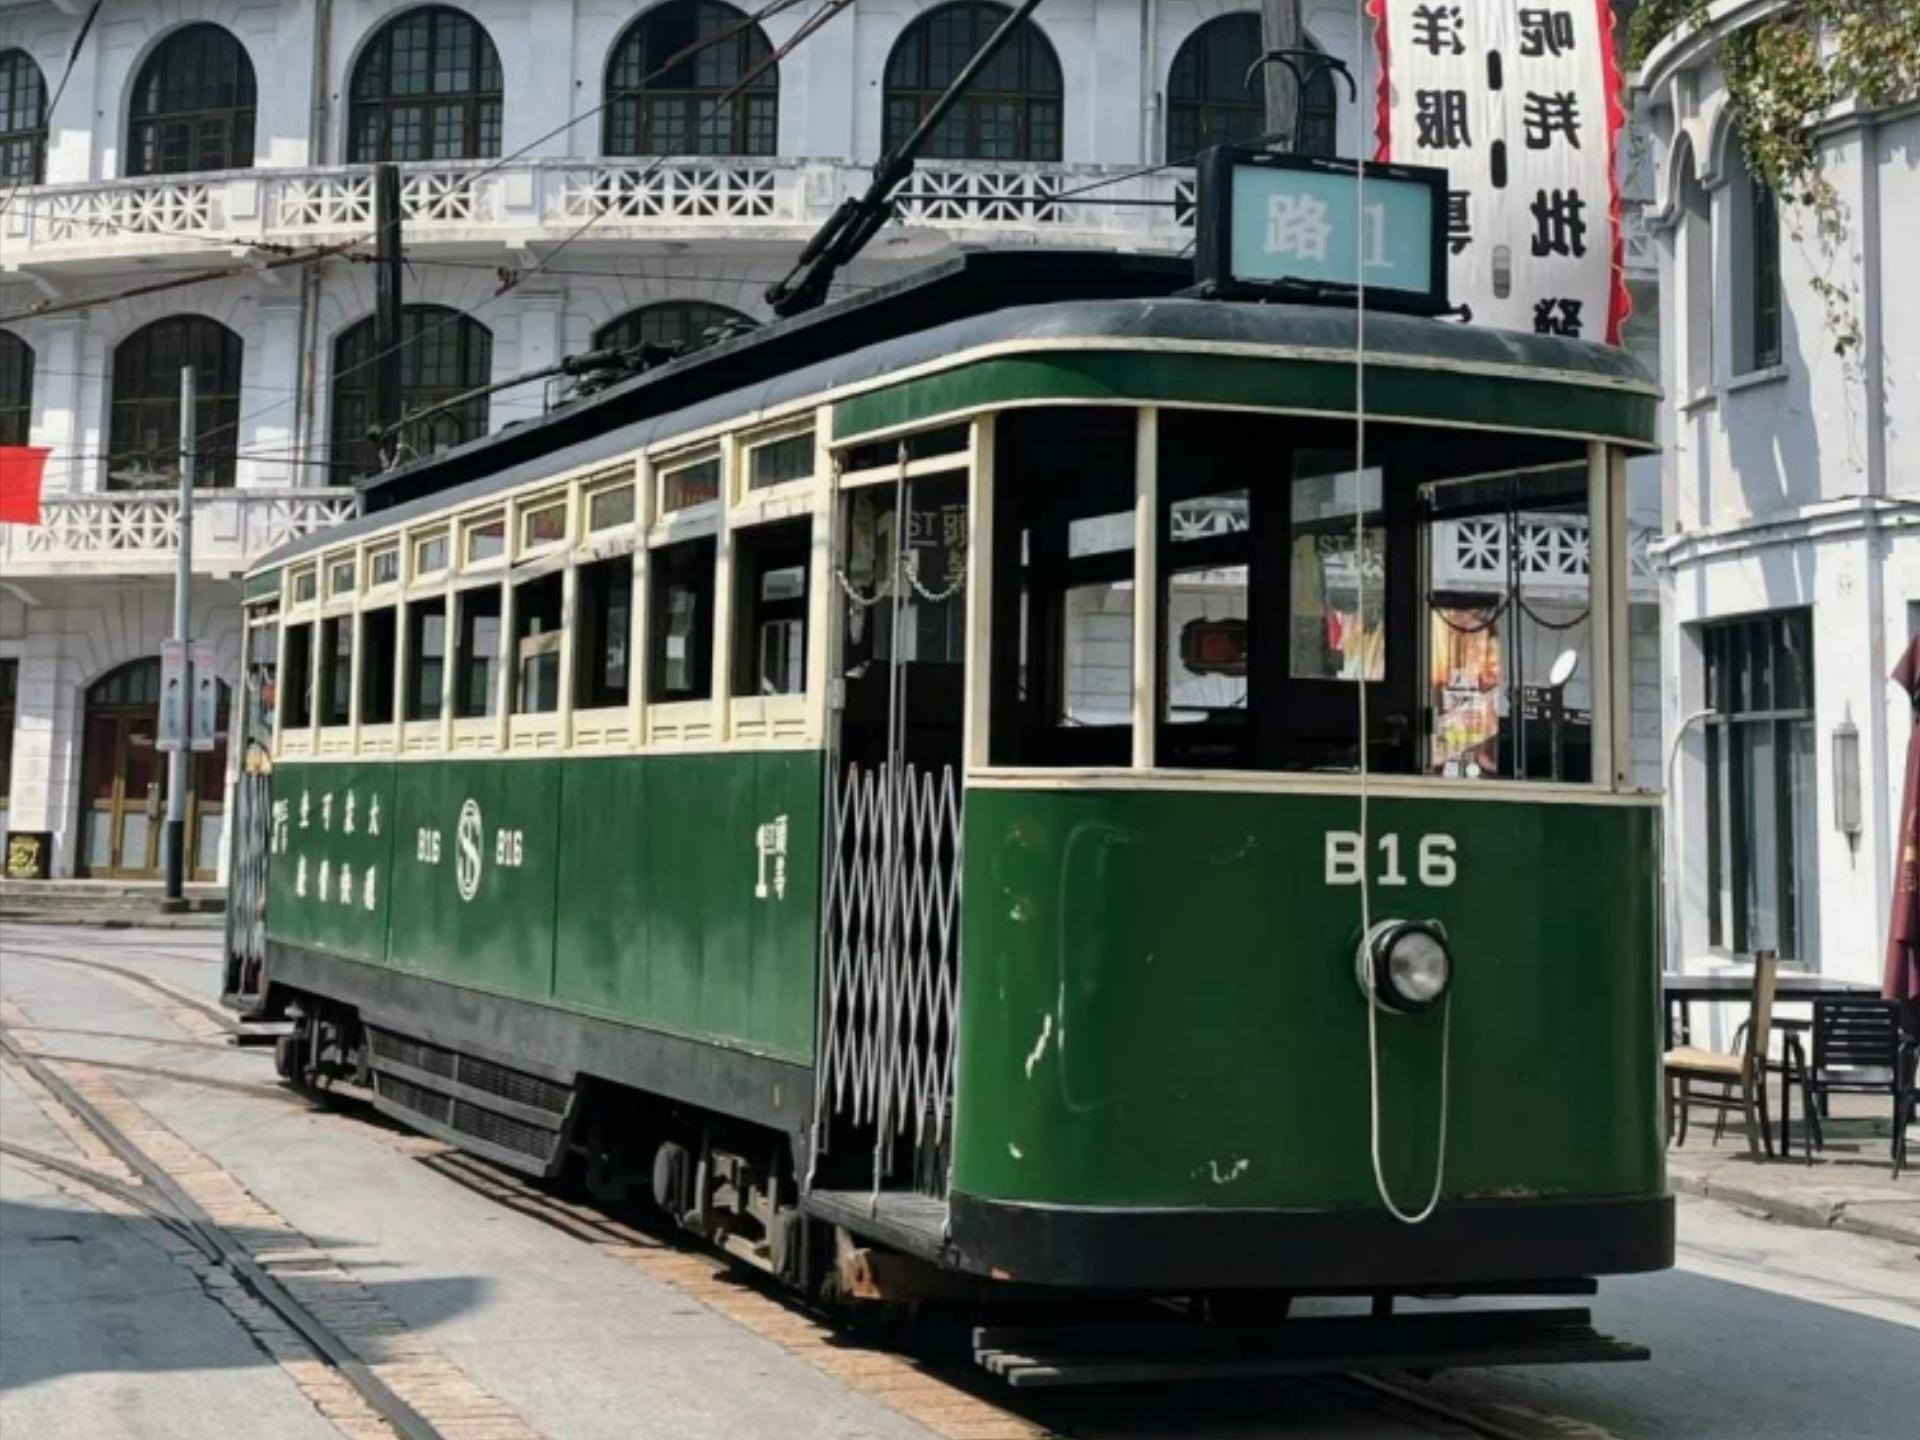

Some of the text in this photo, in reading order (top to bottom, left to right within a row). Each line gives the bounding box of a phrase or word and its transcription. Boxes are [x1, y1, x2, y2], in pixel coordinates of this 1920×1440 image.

[1263, 193, 1395, 268] 路 1
[417, 827, 441, 864] B16
[496, 827, 522, 867] B16
[1325, 831, 1457, 887] B16
